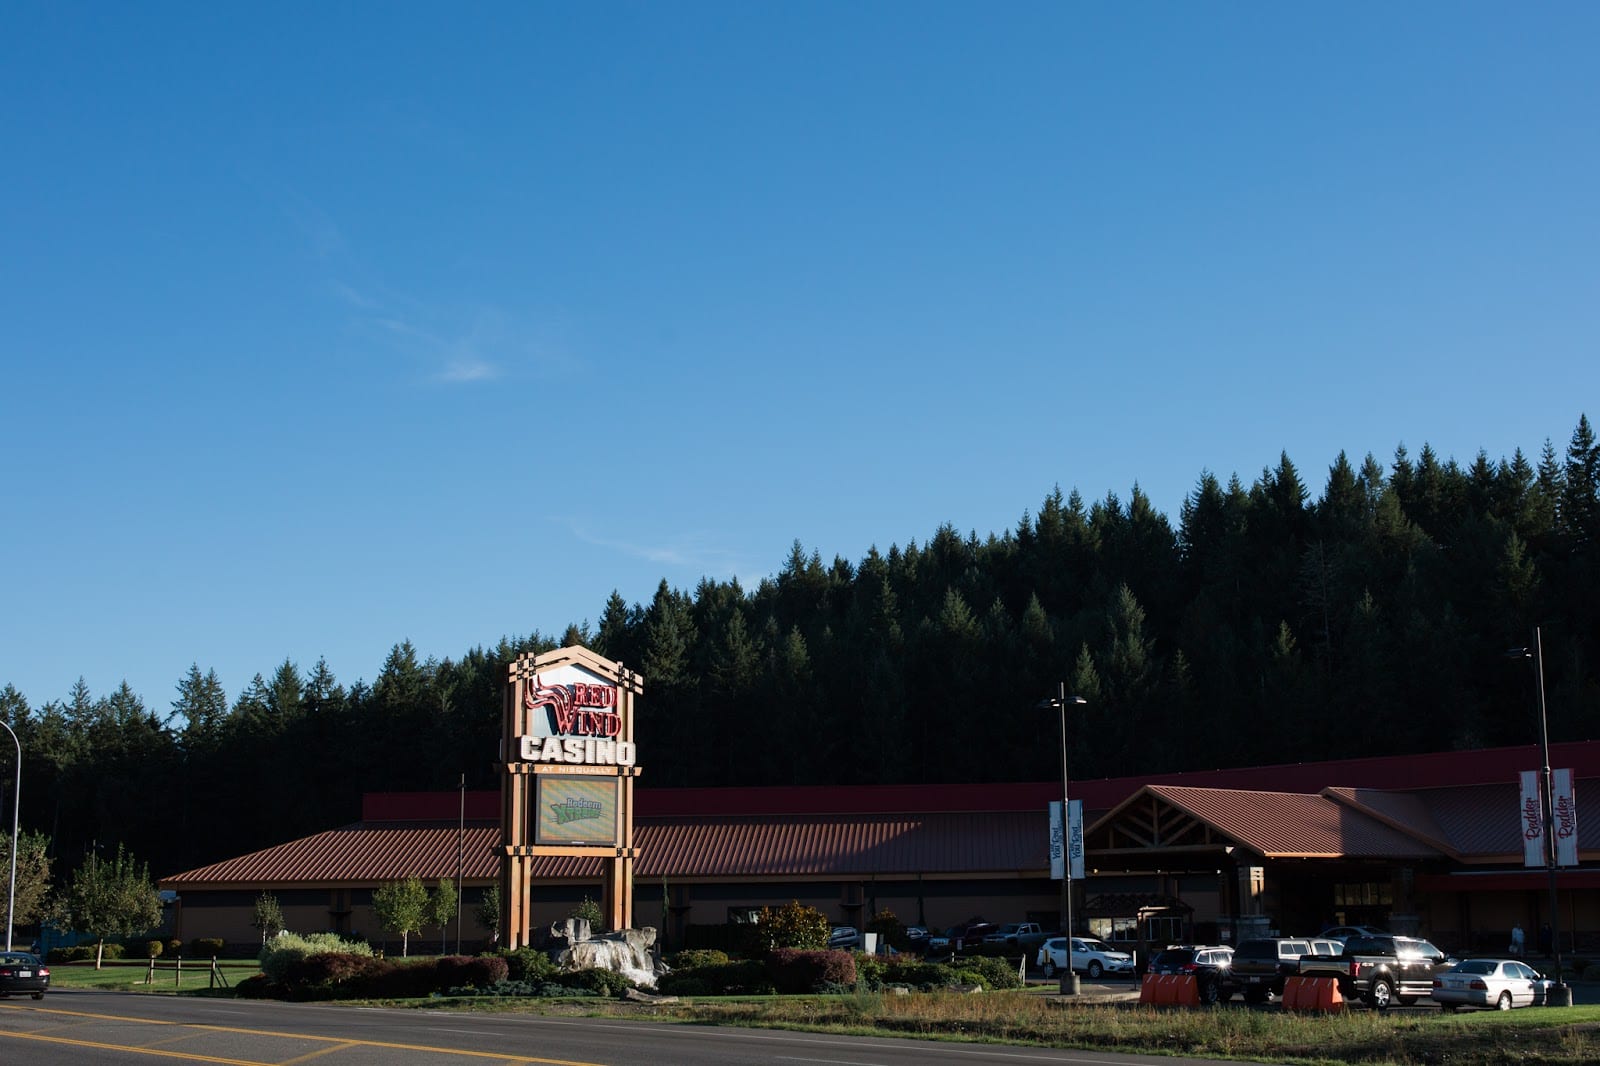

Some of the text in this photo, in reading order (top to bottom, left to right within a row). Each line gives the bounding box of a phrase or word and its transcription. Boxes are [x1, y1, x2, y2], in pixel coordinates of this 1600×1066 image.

[574, 682, 618, 707] RED
[556, 704, 622, 737] WIND
[520, 735, 636, 766] CASINO
[560, 766, 612, 774] NISQUALLY
[1522, 797, 1540, 840] Redder
[1555, 795, 1573, 839] Redder
